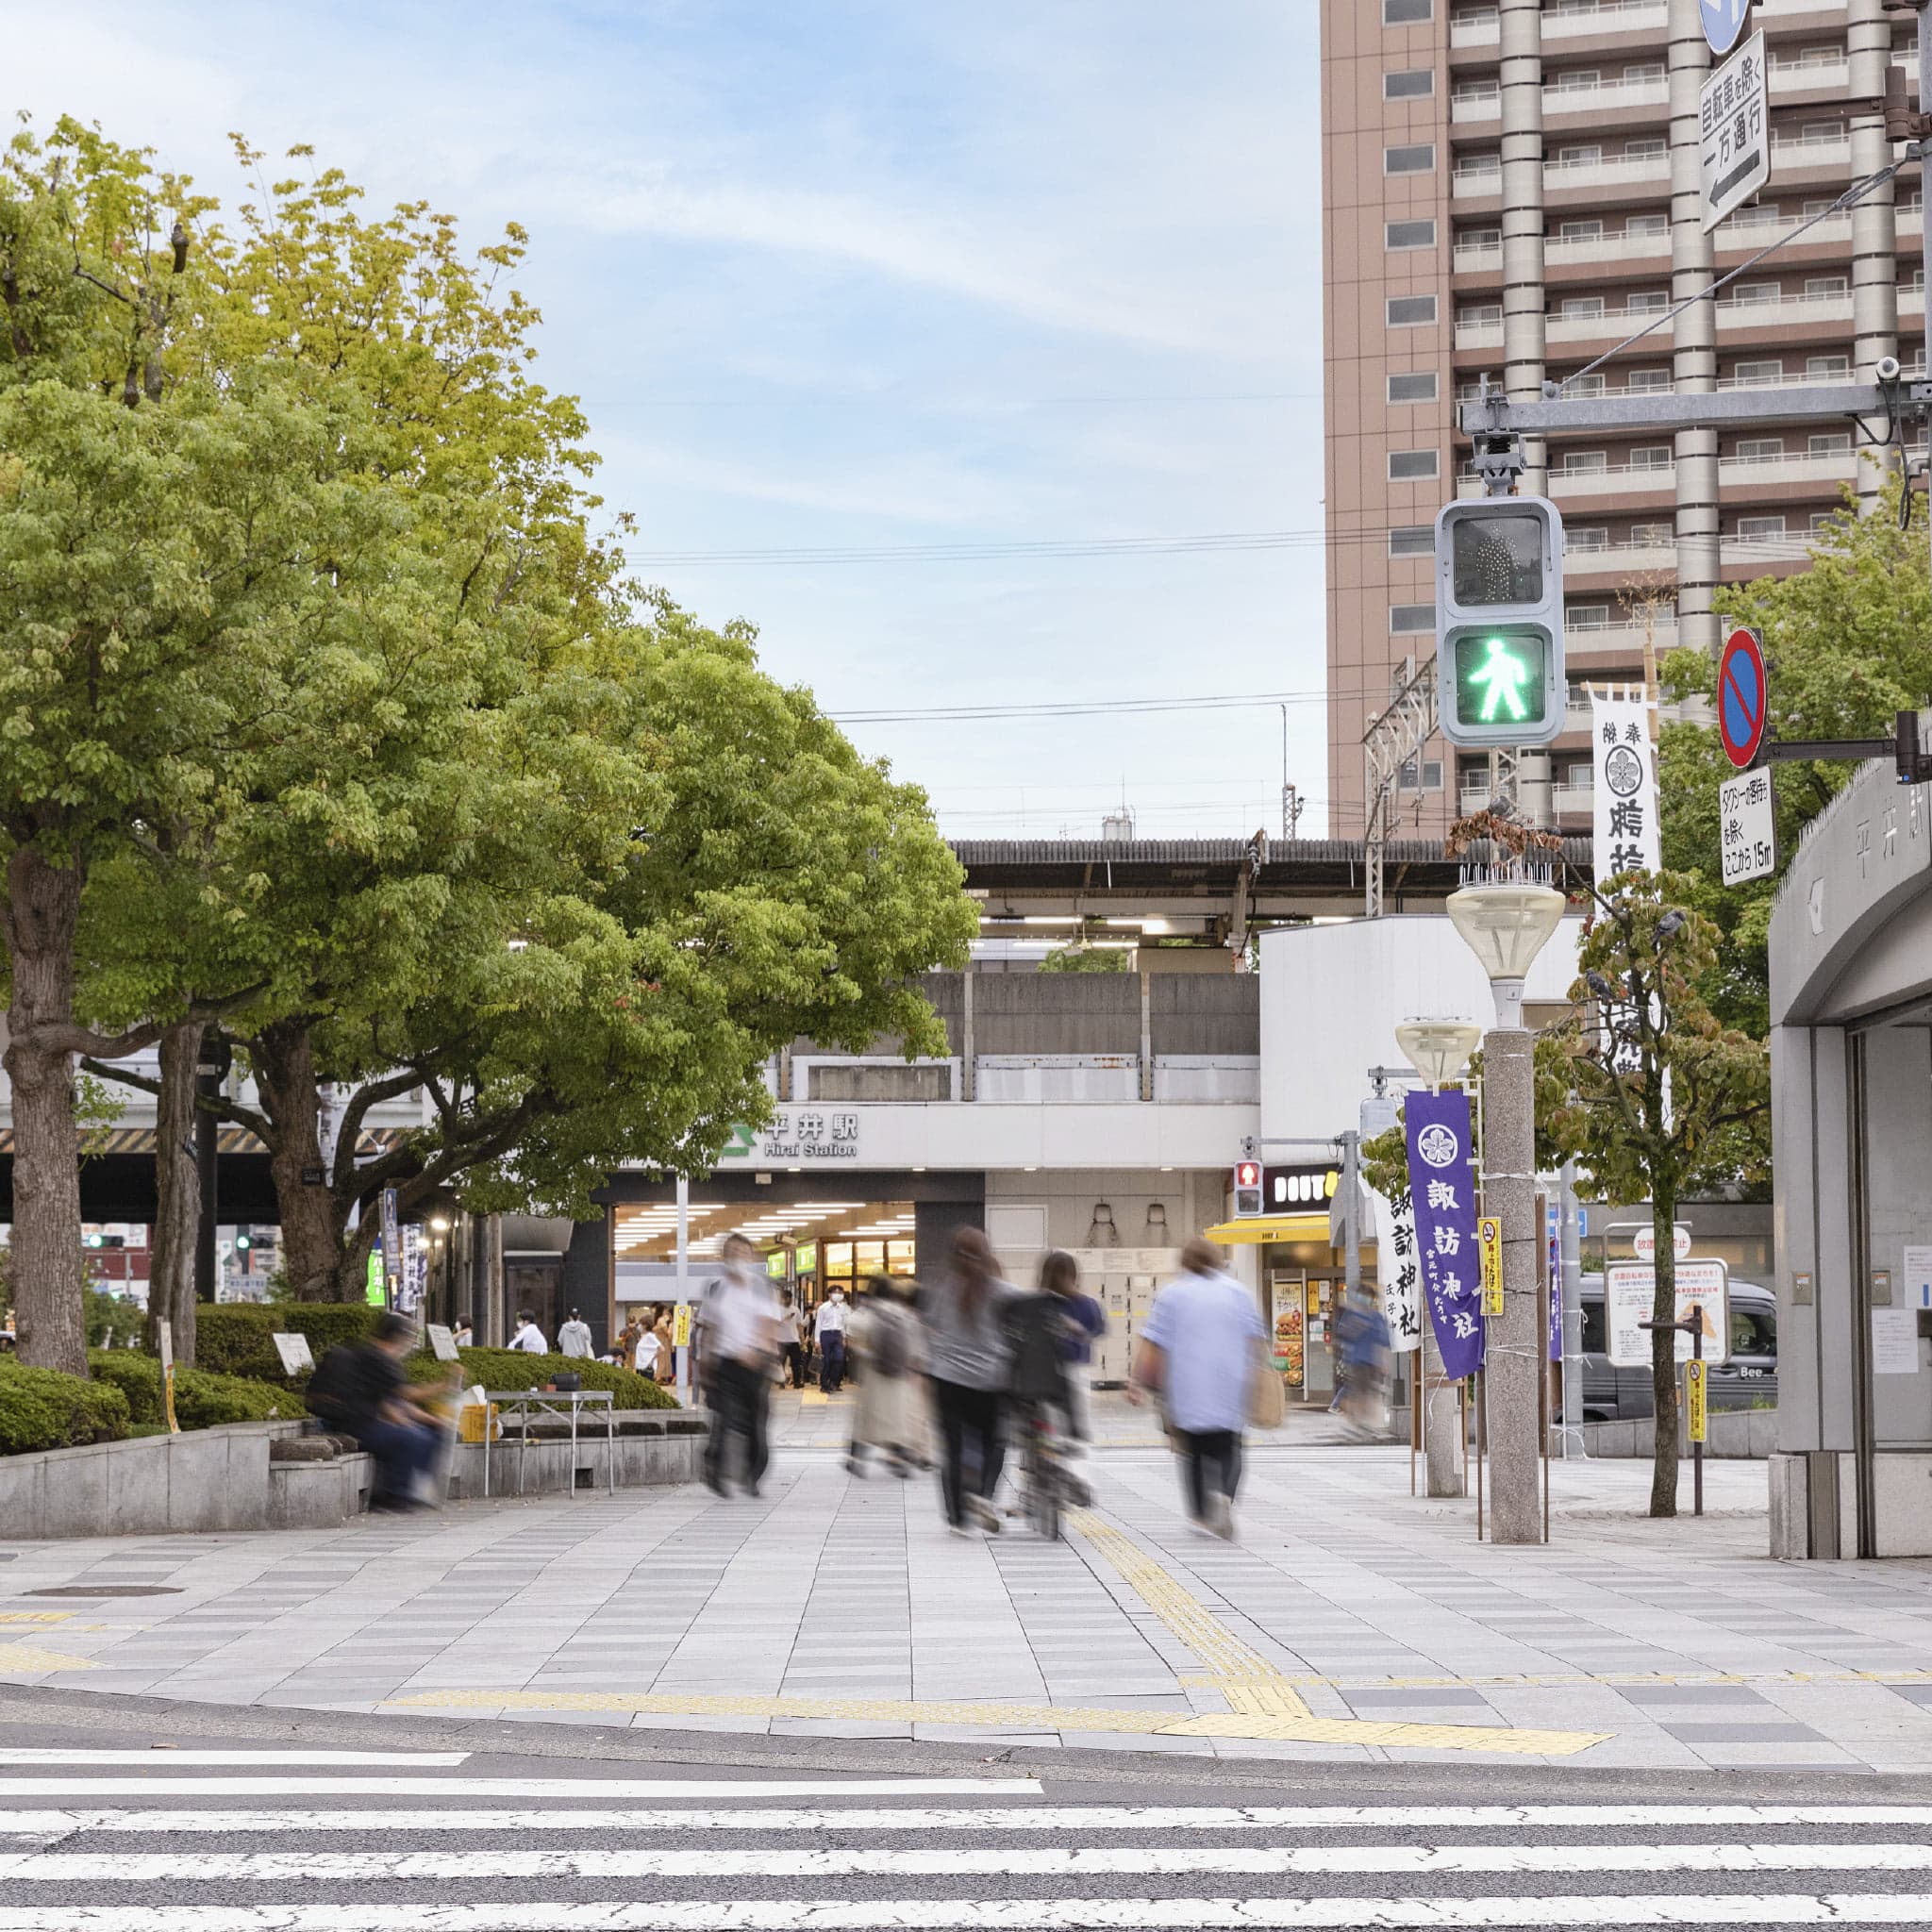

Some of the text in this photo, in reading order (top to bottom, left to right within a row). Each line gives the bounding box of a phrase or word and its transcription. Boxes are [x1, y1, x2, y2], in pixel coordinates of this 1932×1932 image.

[1702, 56, 1761, 133] 自転車を除く
[1704, 98, 1761, 168] 一方通行
[1723, 776, 1768, 814] タクシーの客待ち
[1724, 818, 1744, 846] を除く
[1724, 841, 1772, 876] ここから 15m
[765, 1113, 858, 1140] 平井駅
[764, 1142, 858, 1158] Hirai Station
[1274, 1171, 1341, 1202] DOUTO
[1425, 1179, 1479, 1340] 諏訪神社
[1740, 1366, 1762, 1377] Bee
